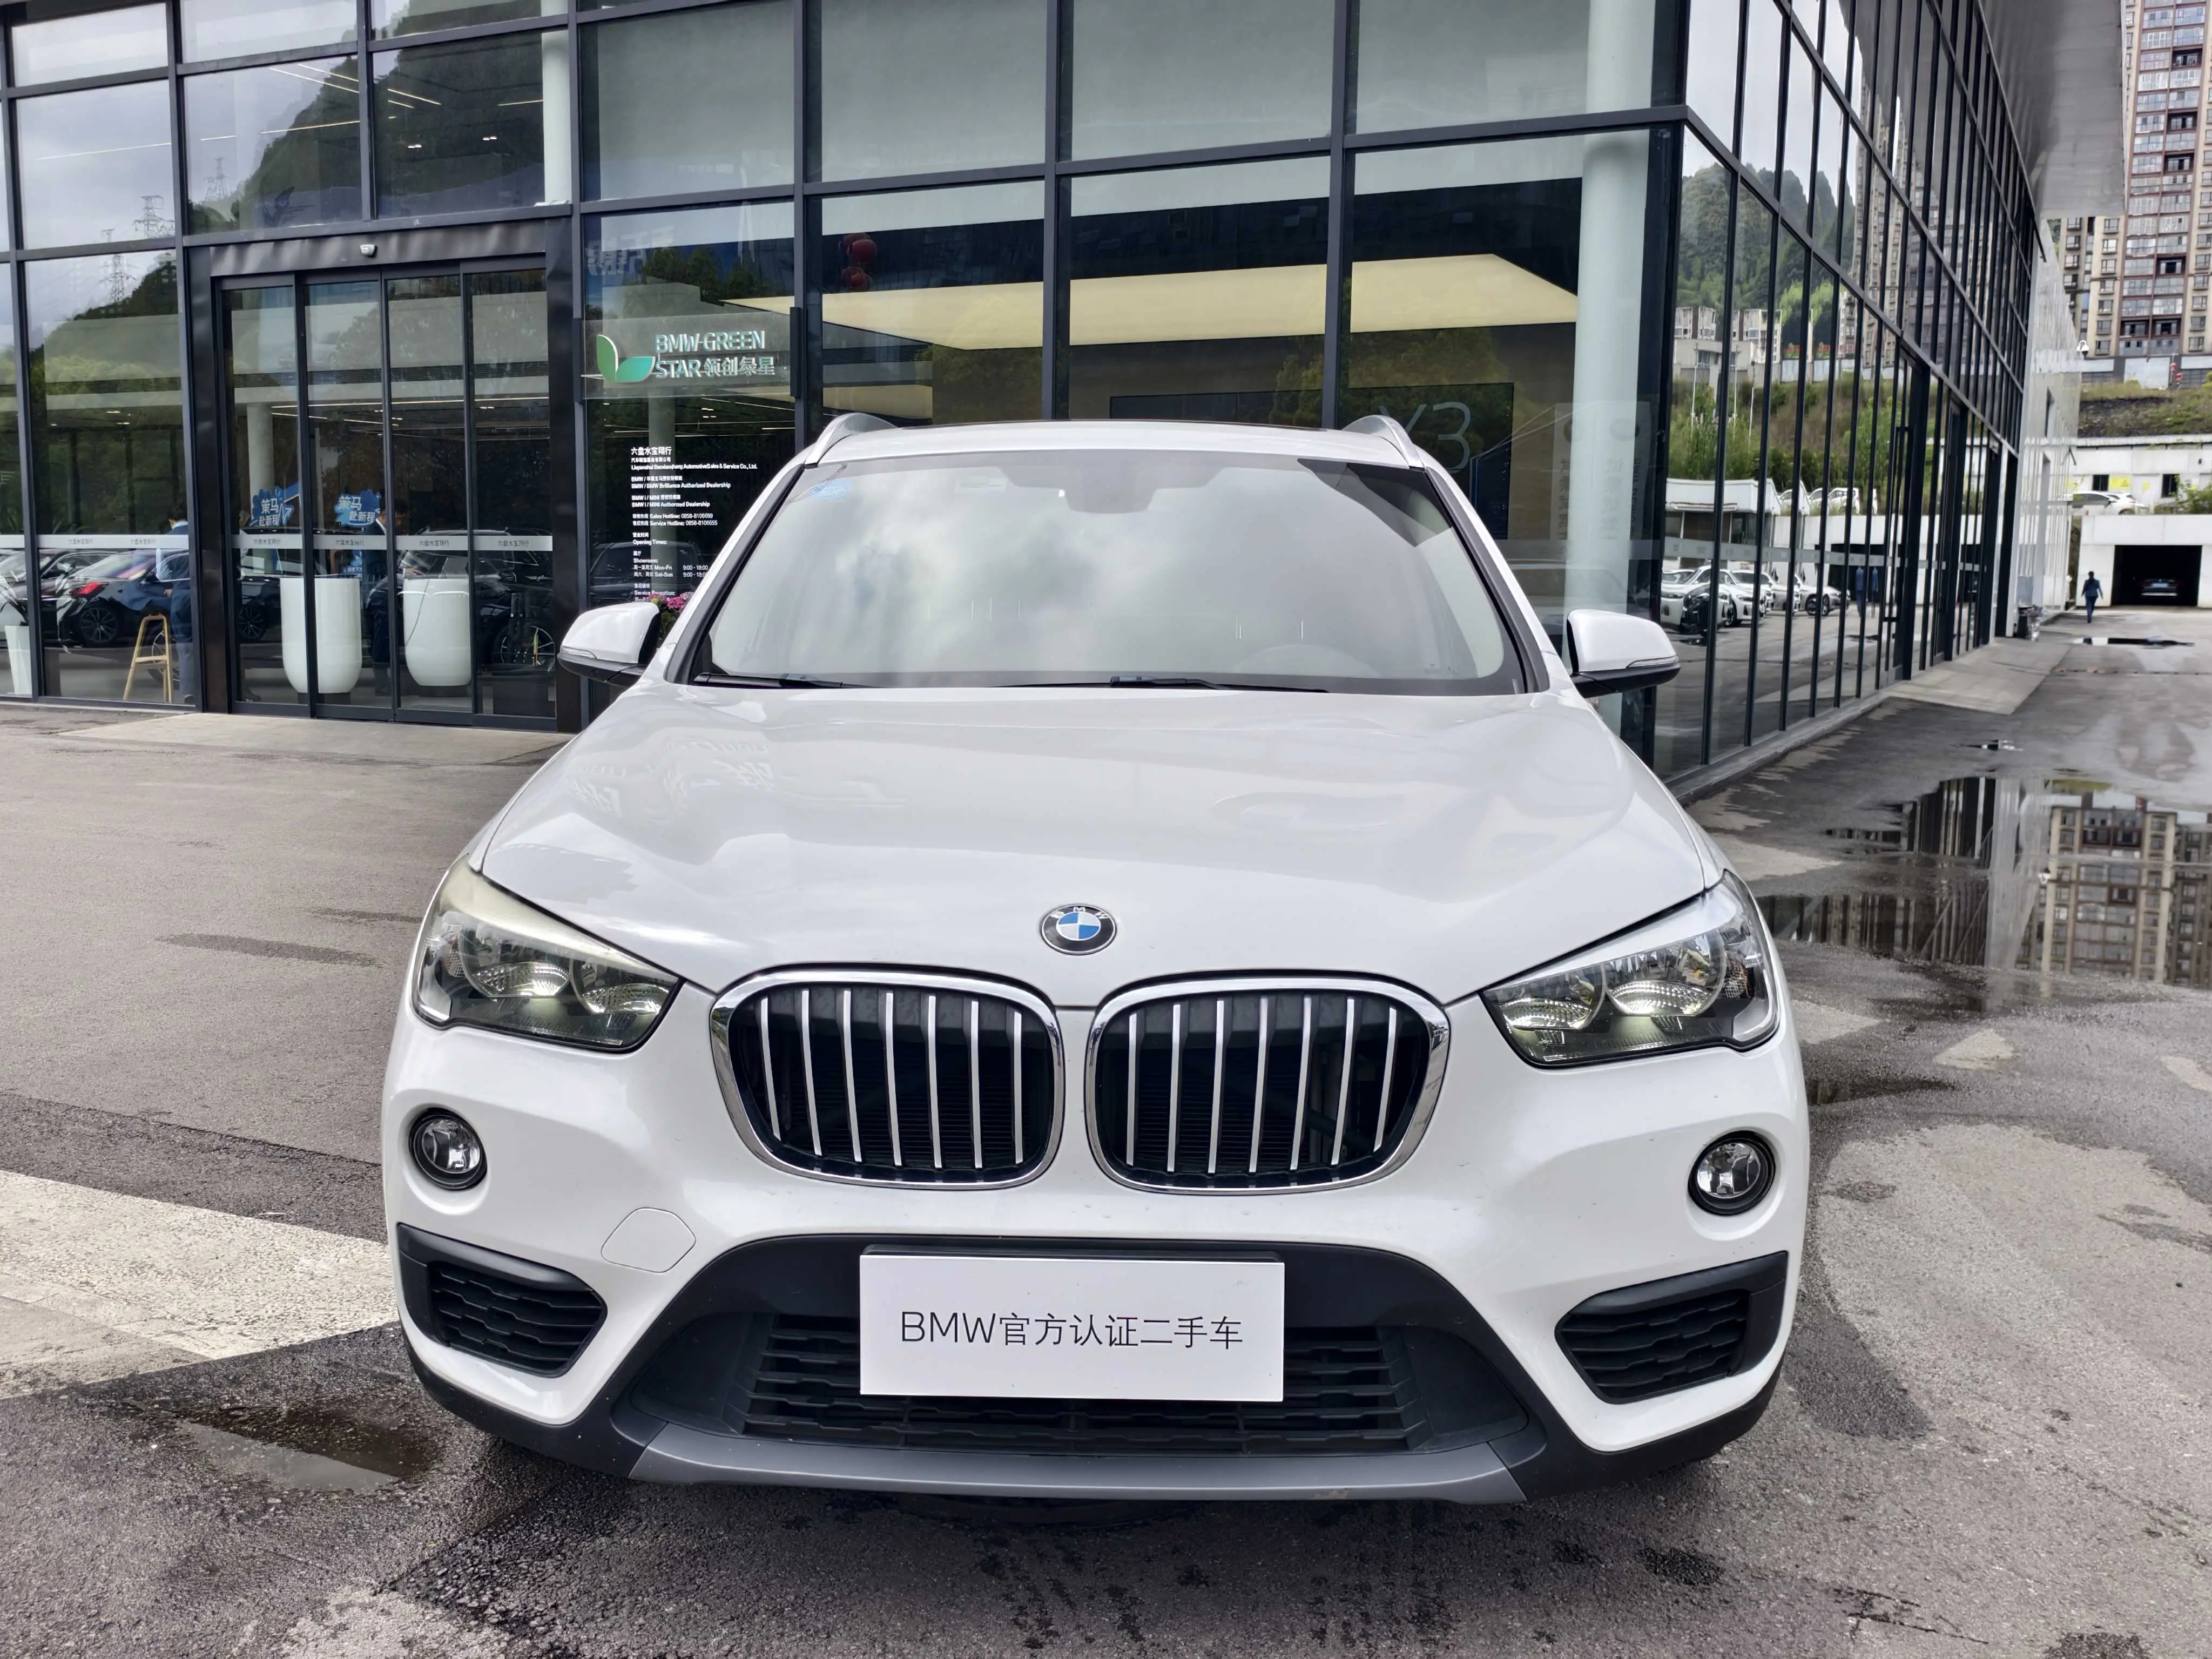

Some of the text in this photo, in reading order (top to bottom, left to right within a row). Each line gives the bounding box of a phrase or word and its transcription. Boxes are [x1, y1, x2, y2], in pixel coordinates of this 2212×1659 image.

[656, 331, 765, 353] BMW GREEN
[655, 356, 775, 378] STAR 领创绿星
[631, 447, 672, 455] 六盘水宝翔行
[261, 498, 279, 514] 策马
[339, 495, 362, 511] 策马
[259, 515, 279, 526] 赴新程
[349, 511, 375, 522] 赴新程
[901, 1311, 1244, 1350] BMW官方认证二手车
